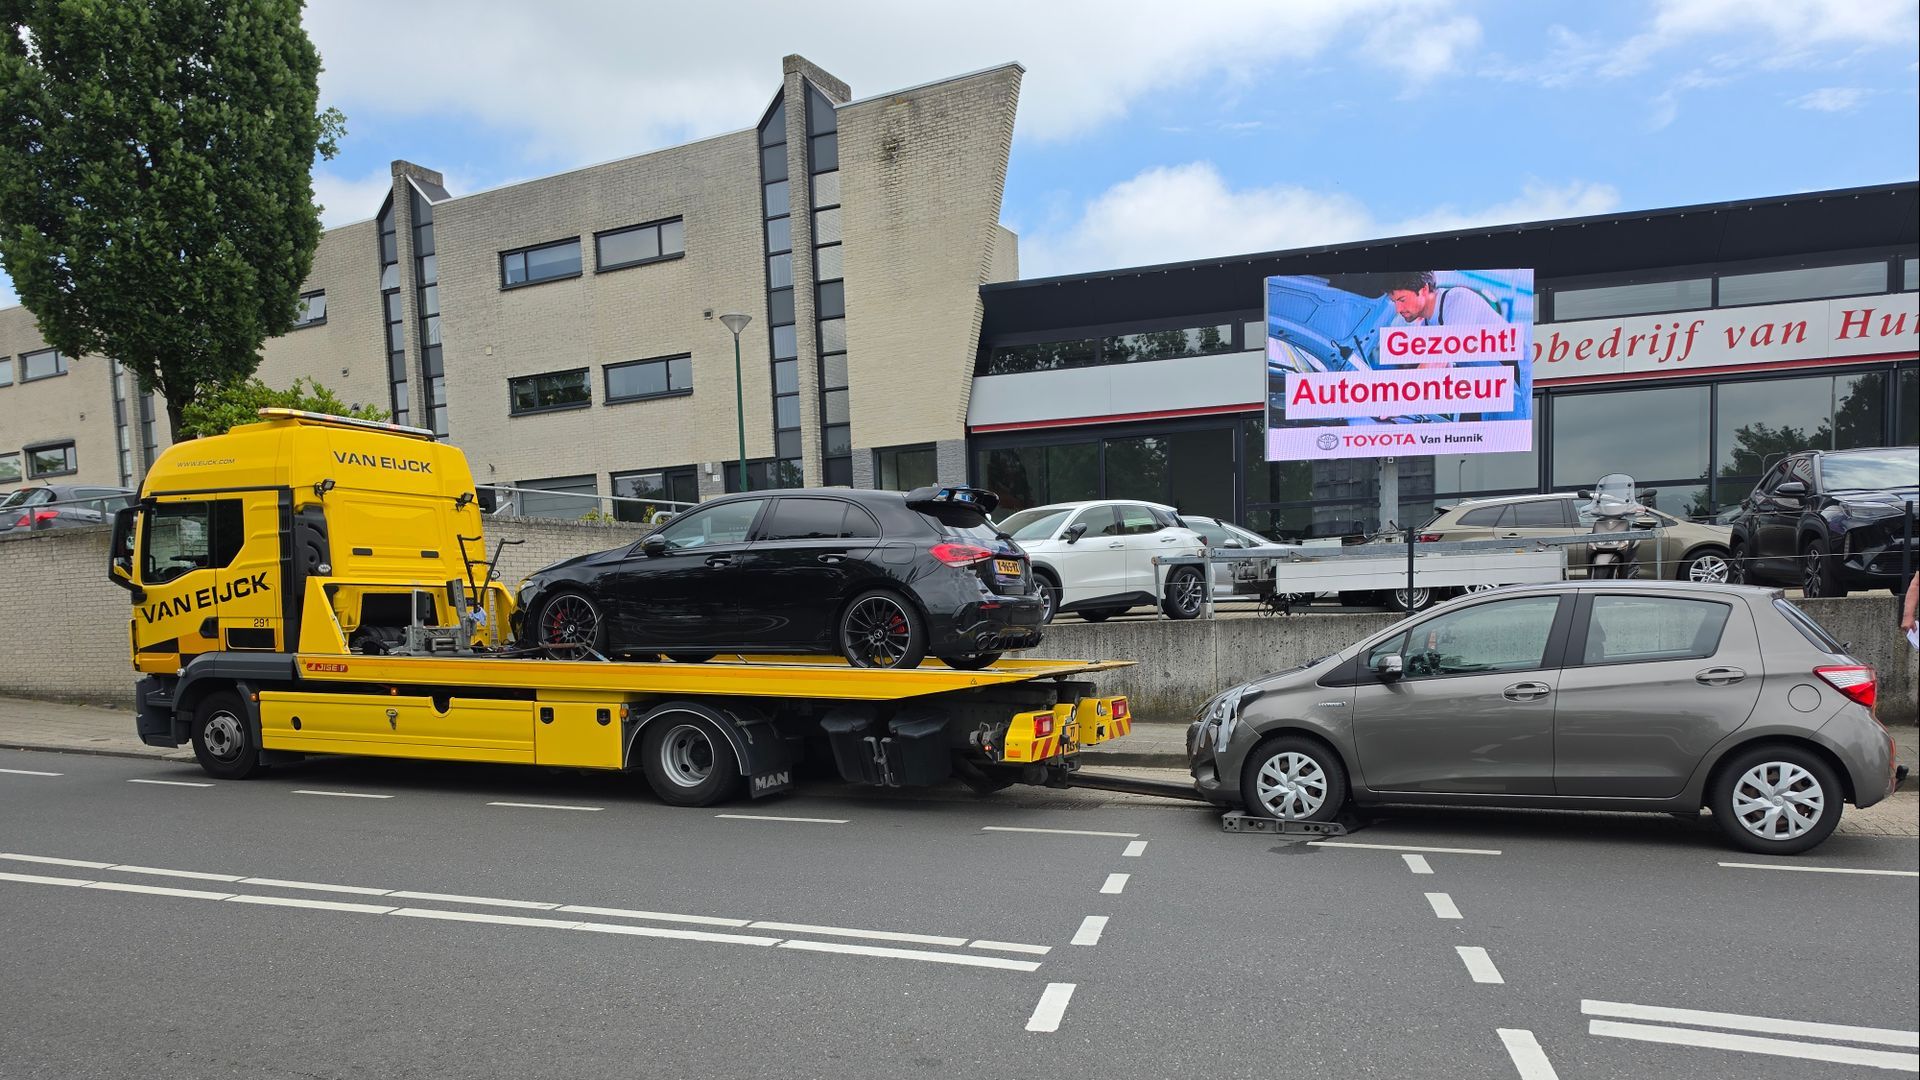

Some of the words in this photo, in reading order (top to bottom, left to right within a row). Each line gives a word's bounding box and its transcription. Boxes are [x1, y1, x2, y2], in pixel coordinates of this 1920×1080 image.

[1387, 327, 1517, 357] Gezocht!
[1723, 319, 1807, 350] van
[1292, 374, 1507, 406] Automonteur
[1343, 433, 1416, 448] TOYOTA
[1420, 434, 1441, 444] Van
[1444, 433, 1484, 444] Hunnik
[333, 450, 376, 468] VAN
[380, 456, 432, 474] EIJCK
[141, 593, 192, 624] VAN
[195, 571, 271, 610] EIJCK
[253, 618, 270, 628] 291
[755, 771, 789, 791] MAN
